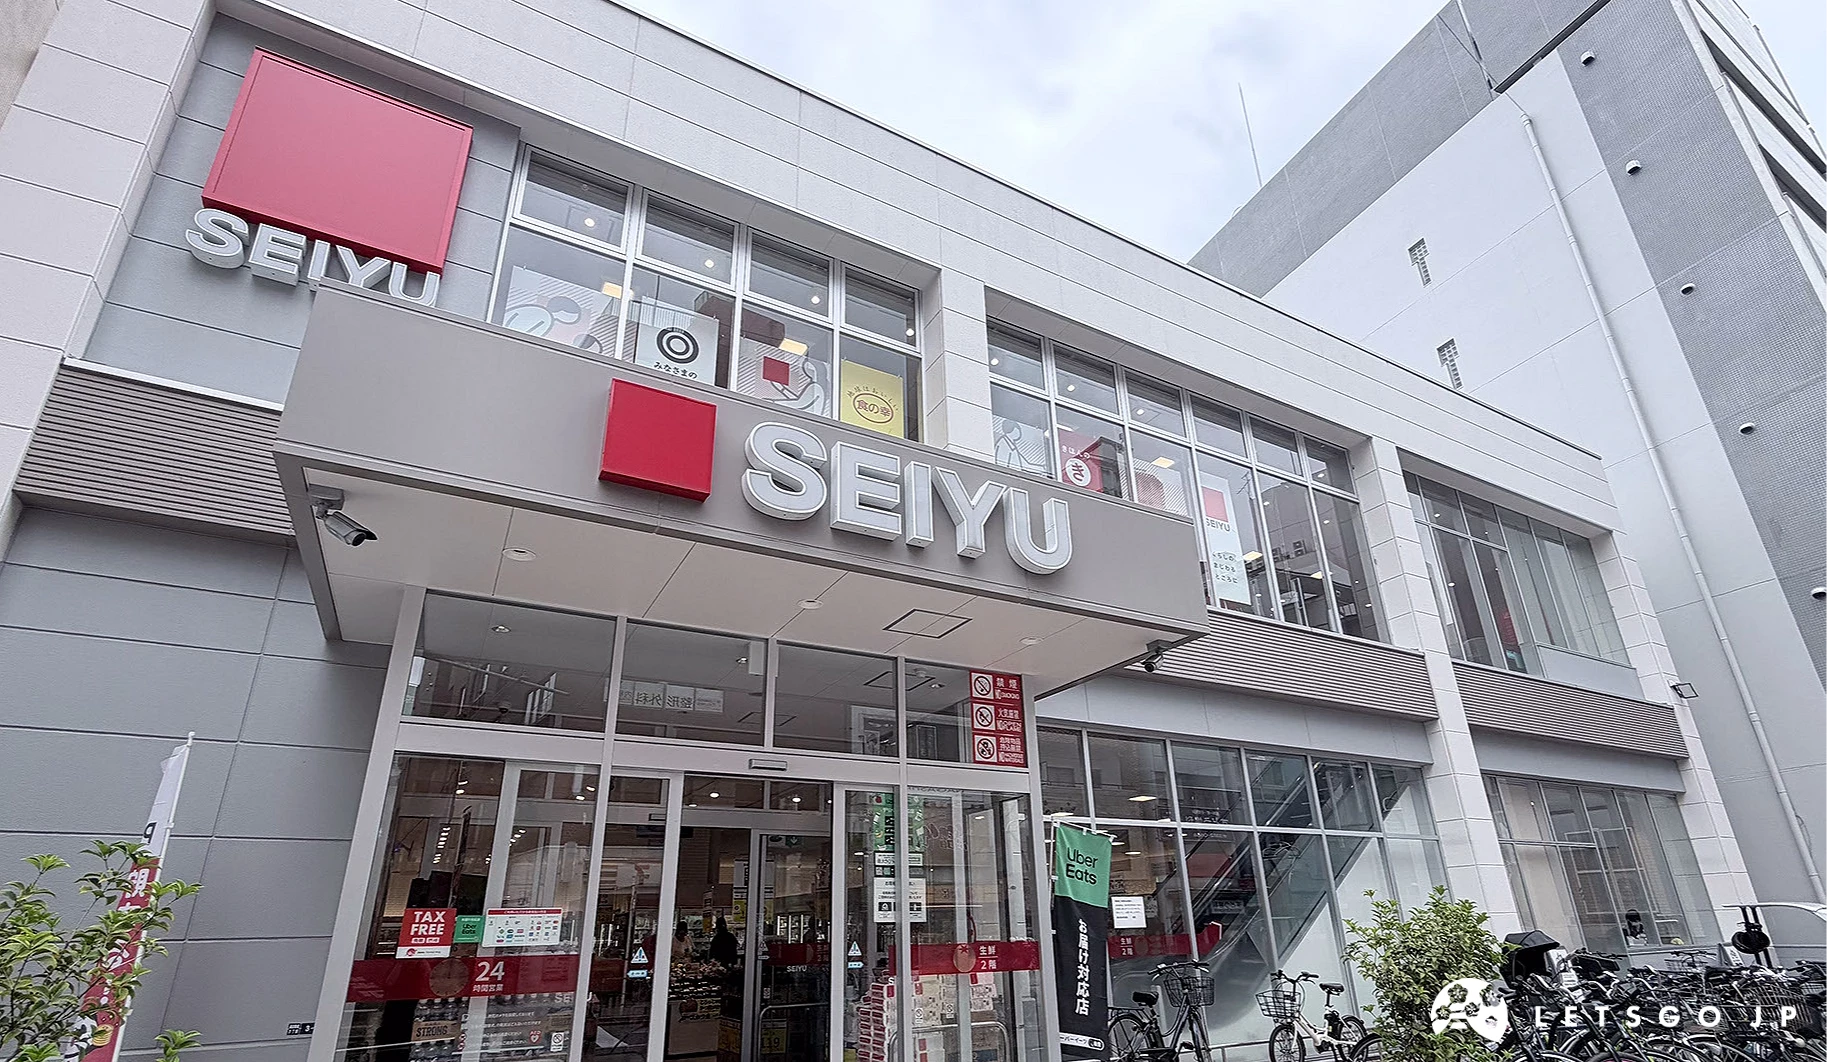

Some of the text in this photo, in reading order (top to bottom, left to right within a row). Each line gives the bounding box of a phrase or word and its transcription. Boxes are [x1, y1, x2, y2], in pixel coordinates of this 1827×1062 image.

[185, 208, 441, 307] SEIYU
[653, 361, 698, 380] みなさまの
[856, 399, 892, 418] 食の幸
[1071, 462, 1085, 482] き
[742, 422, 1073, 575] SEIYU
[1205, 517, 1231, 532] SEIYU
[1066, 846, 1098, 869] Uber
[1065, 864, 1098, 885] Eats
[413, 911, 446, 923] TAX
[410, 923, 445, 936] FREE
[979, 945, 996, 956] 生鮮
[475, 961, 505, 982] 24
[786, 965, 807, 973] SEIYU
[980, 959, 997, 970] 2階
[1075, 918, 1090, 1016] お届け対応店
[472, 983, 504, 993] 時間営業
